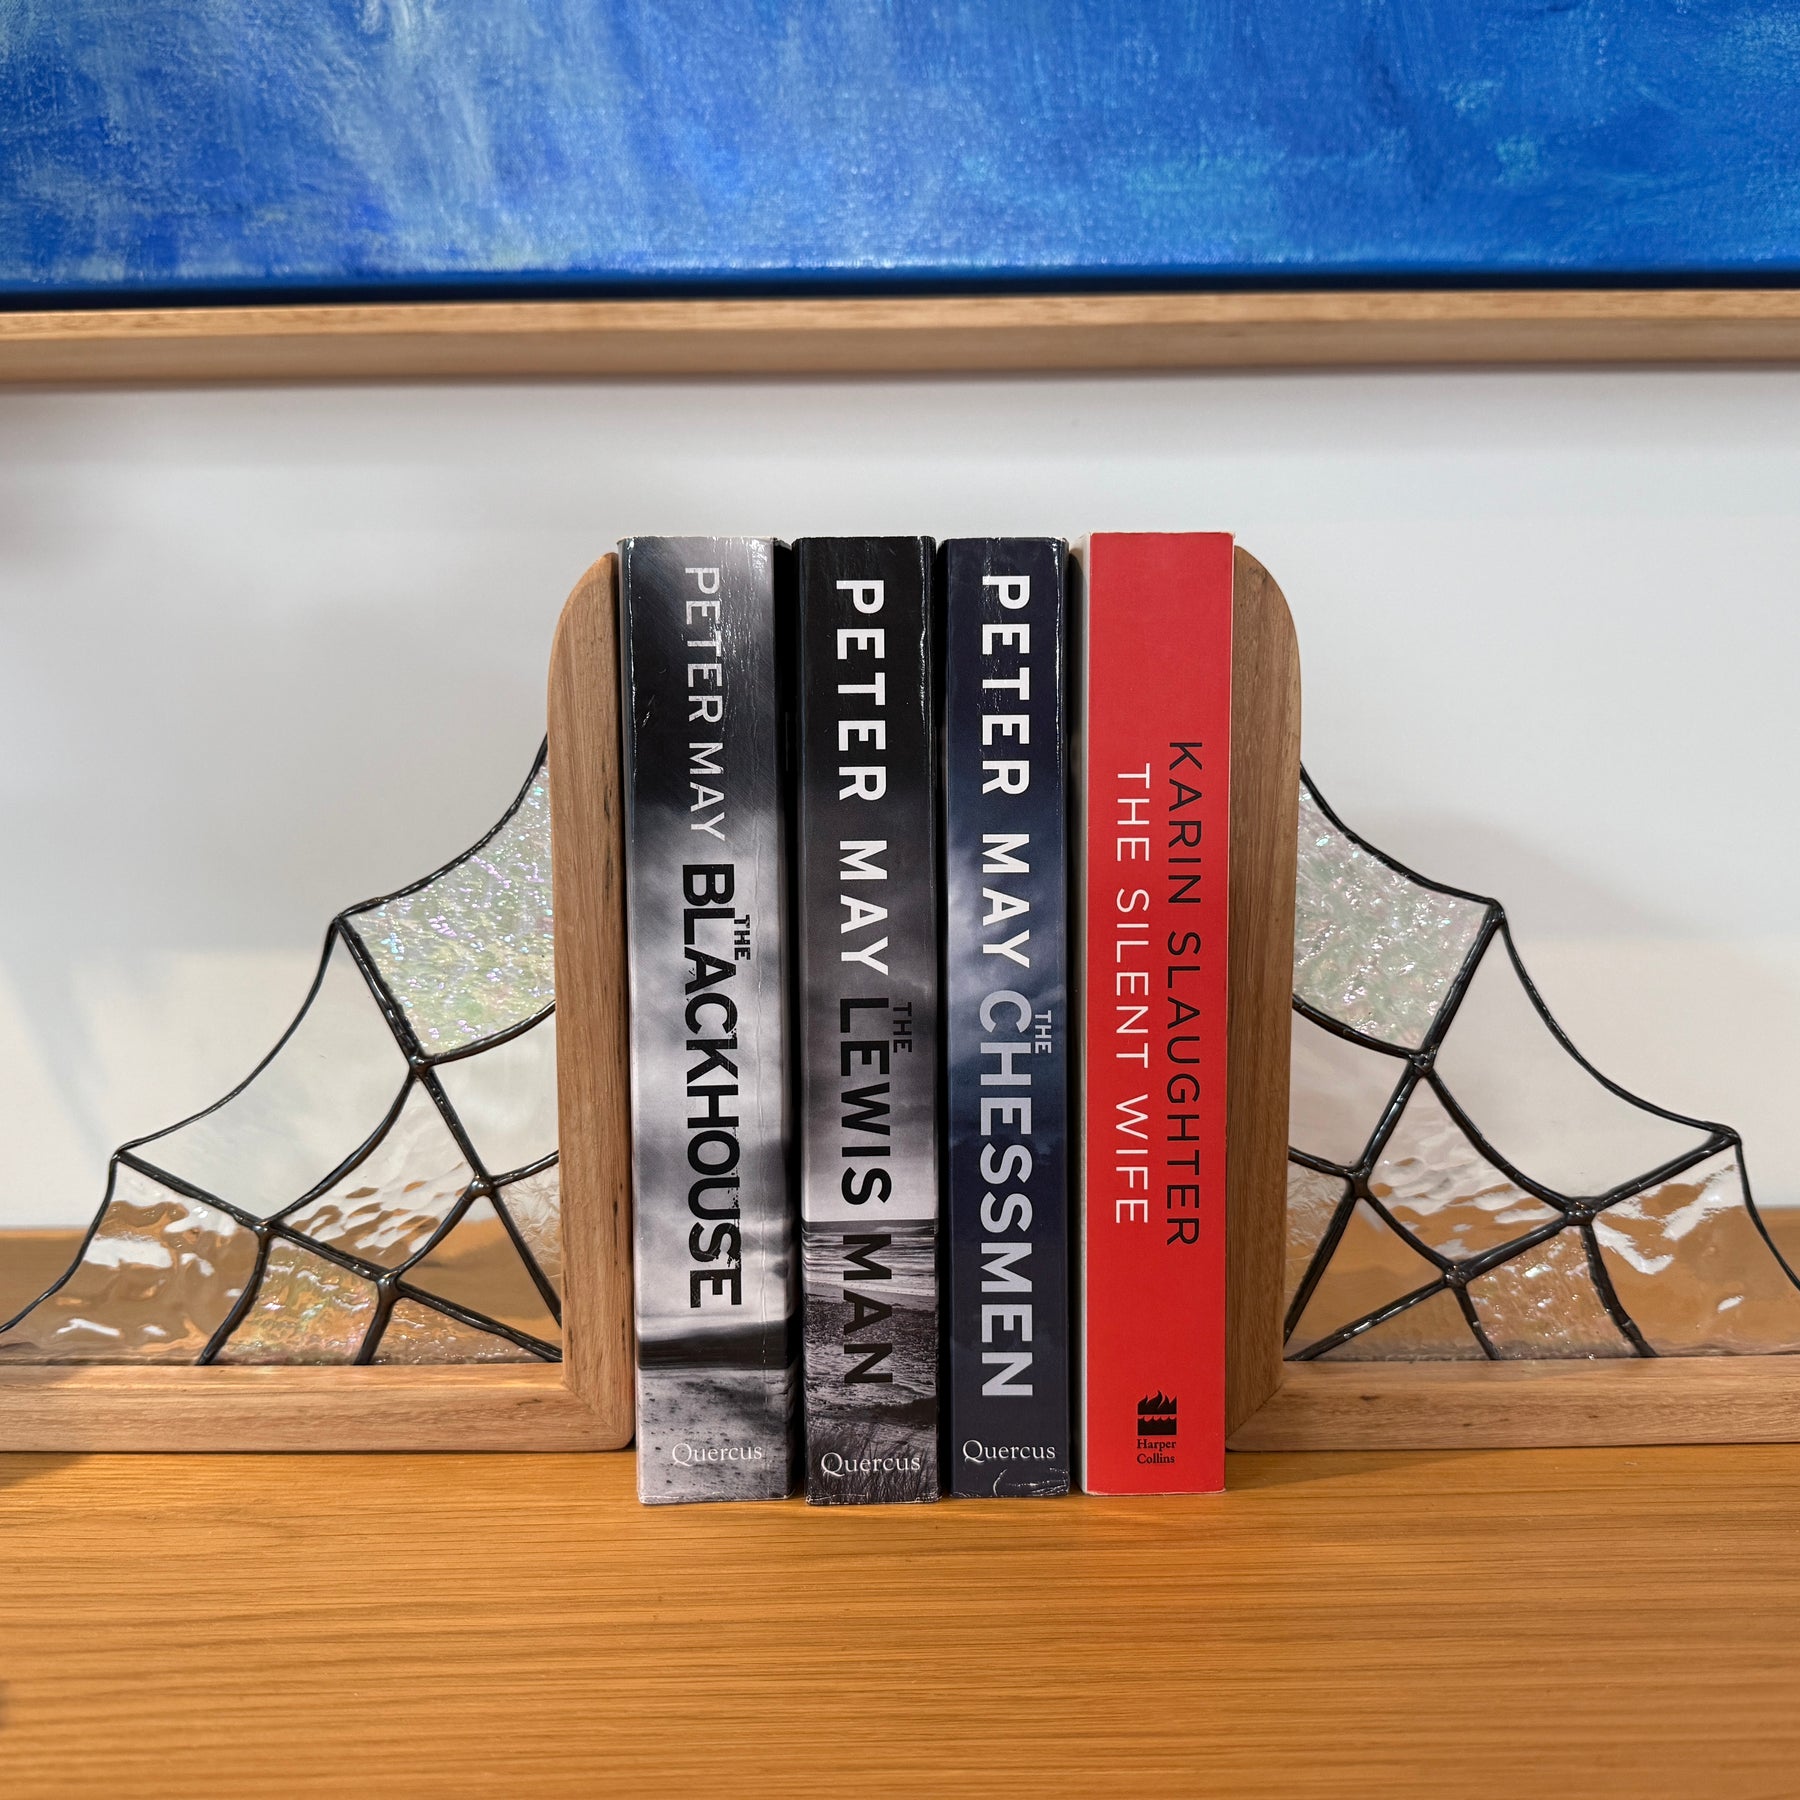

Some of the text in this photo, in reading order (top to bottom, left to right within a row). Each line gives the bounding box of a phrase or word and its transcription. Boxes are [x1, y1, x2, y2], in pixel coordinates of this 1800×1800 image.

[684, 567, 727, 842] PETER MAY
[836, 579, 890, 976] PETER MAY
[982, 574, 1031, 968] PETER MAY
[733, 915, 751, 961] THE
[1115, 762, 1151, 1224] THE SILENT WIFE
[1166, 741, 1203, 1246] KARIN SLAUGHTER
[682, 863, 742, 1309] BLACKHOUSE
[893, 1001, 913, 1054] THE
[1033, 1010, 1052, 1055] THE
[839, 997, 893, 1385] LEWIS MAN
[979, 989, 1033, 1398] CHESSMEN
[671, 1442, 763, 1467] Quercus
[820, 1451, 922, 1477] Quercus
[961, 1438, 1057, 1463] Quercus
[1136, 1438, 1177, 1453] Harper
[1136, 1451, 1176, 1464] Collins
